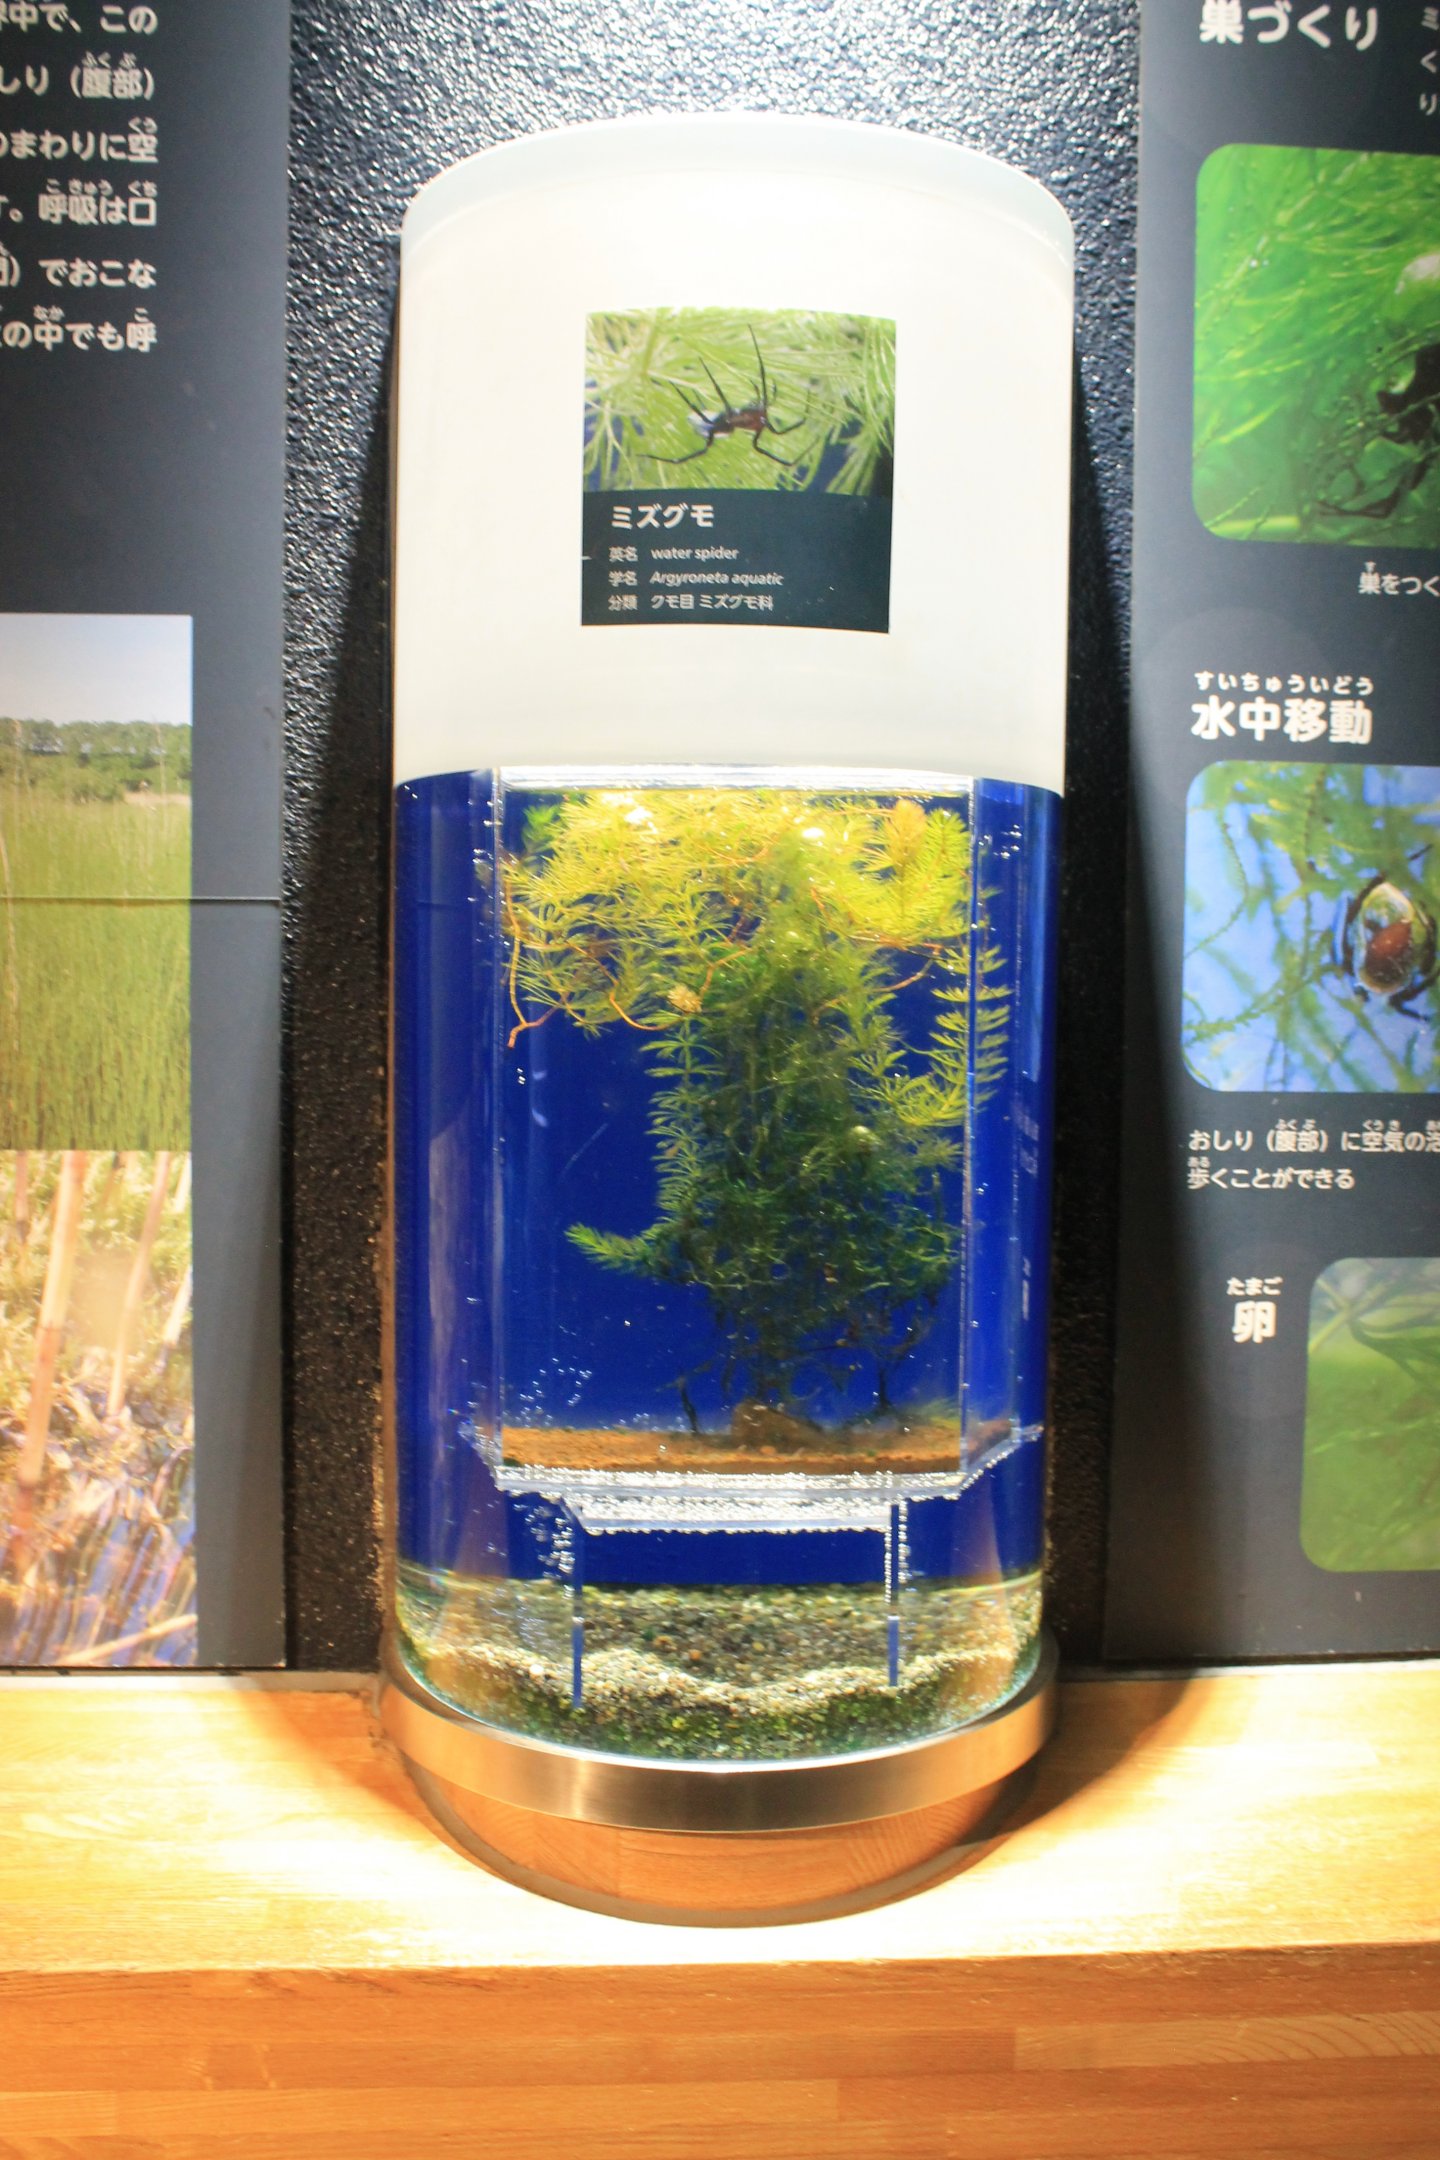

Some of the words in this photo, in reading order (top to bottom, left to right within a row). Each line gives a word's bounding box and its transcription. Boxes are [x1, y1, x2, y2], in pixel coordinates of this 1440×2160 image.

[1199, 0, 1378, 50] 巣づくり
[611, 503, 715, 530] ミズグモ
[608, 546, 638, 563] 英名
[650, 547, 692, 560] water
[694, 546, 740, 562] spider
[608, 570, 638, 587] 学名
[650, 571, 730, 587] Argyroneta
[731, 572, 784, 587] aquatic
[650, 594, 694, 610] クモ目
[699, 593, 774, 612] ミズグモ科
[1194, 670, 1375, 696] すいちゅういどう
[1190, 694, 1374, 745] 水中移動
[1187, 1167, 1356, 1190] 歩くことができる
[1226, 1277, 1284, 1296] たまご
[1232, 1300, 1277, 1344] 卵
